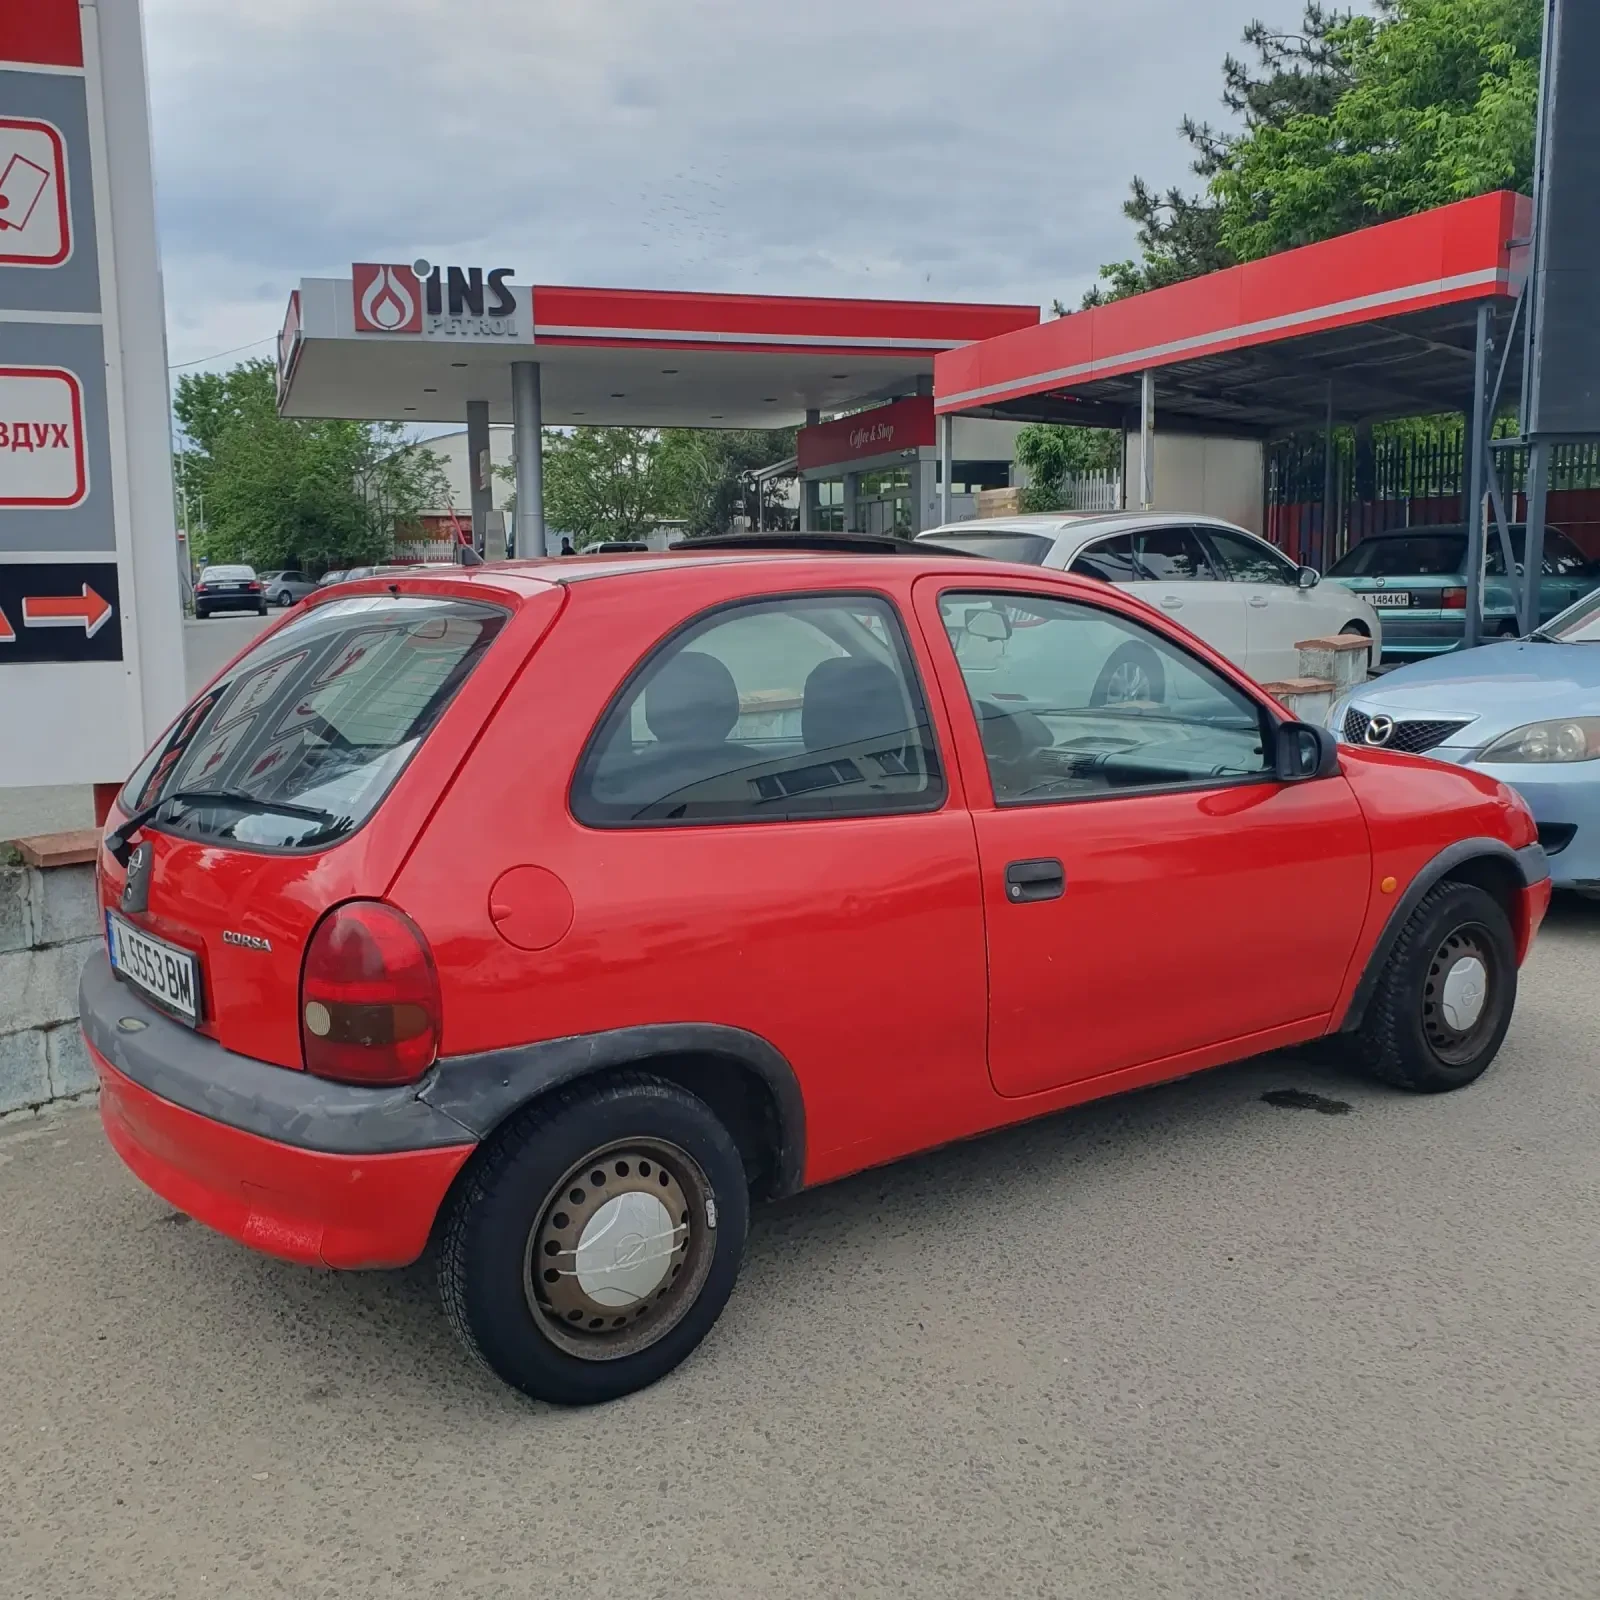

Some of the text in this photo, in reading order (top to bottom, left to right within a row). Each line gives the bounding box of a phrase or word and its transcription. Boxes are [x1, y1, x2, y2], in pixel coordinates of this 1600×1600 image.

[426, 265, 517, 316] INS
[427, 318, 518, 337] PETROL
[850, 423, 894, 448] Coffee & Shop
[222, 930, 272, 952] CORSA
